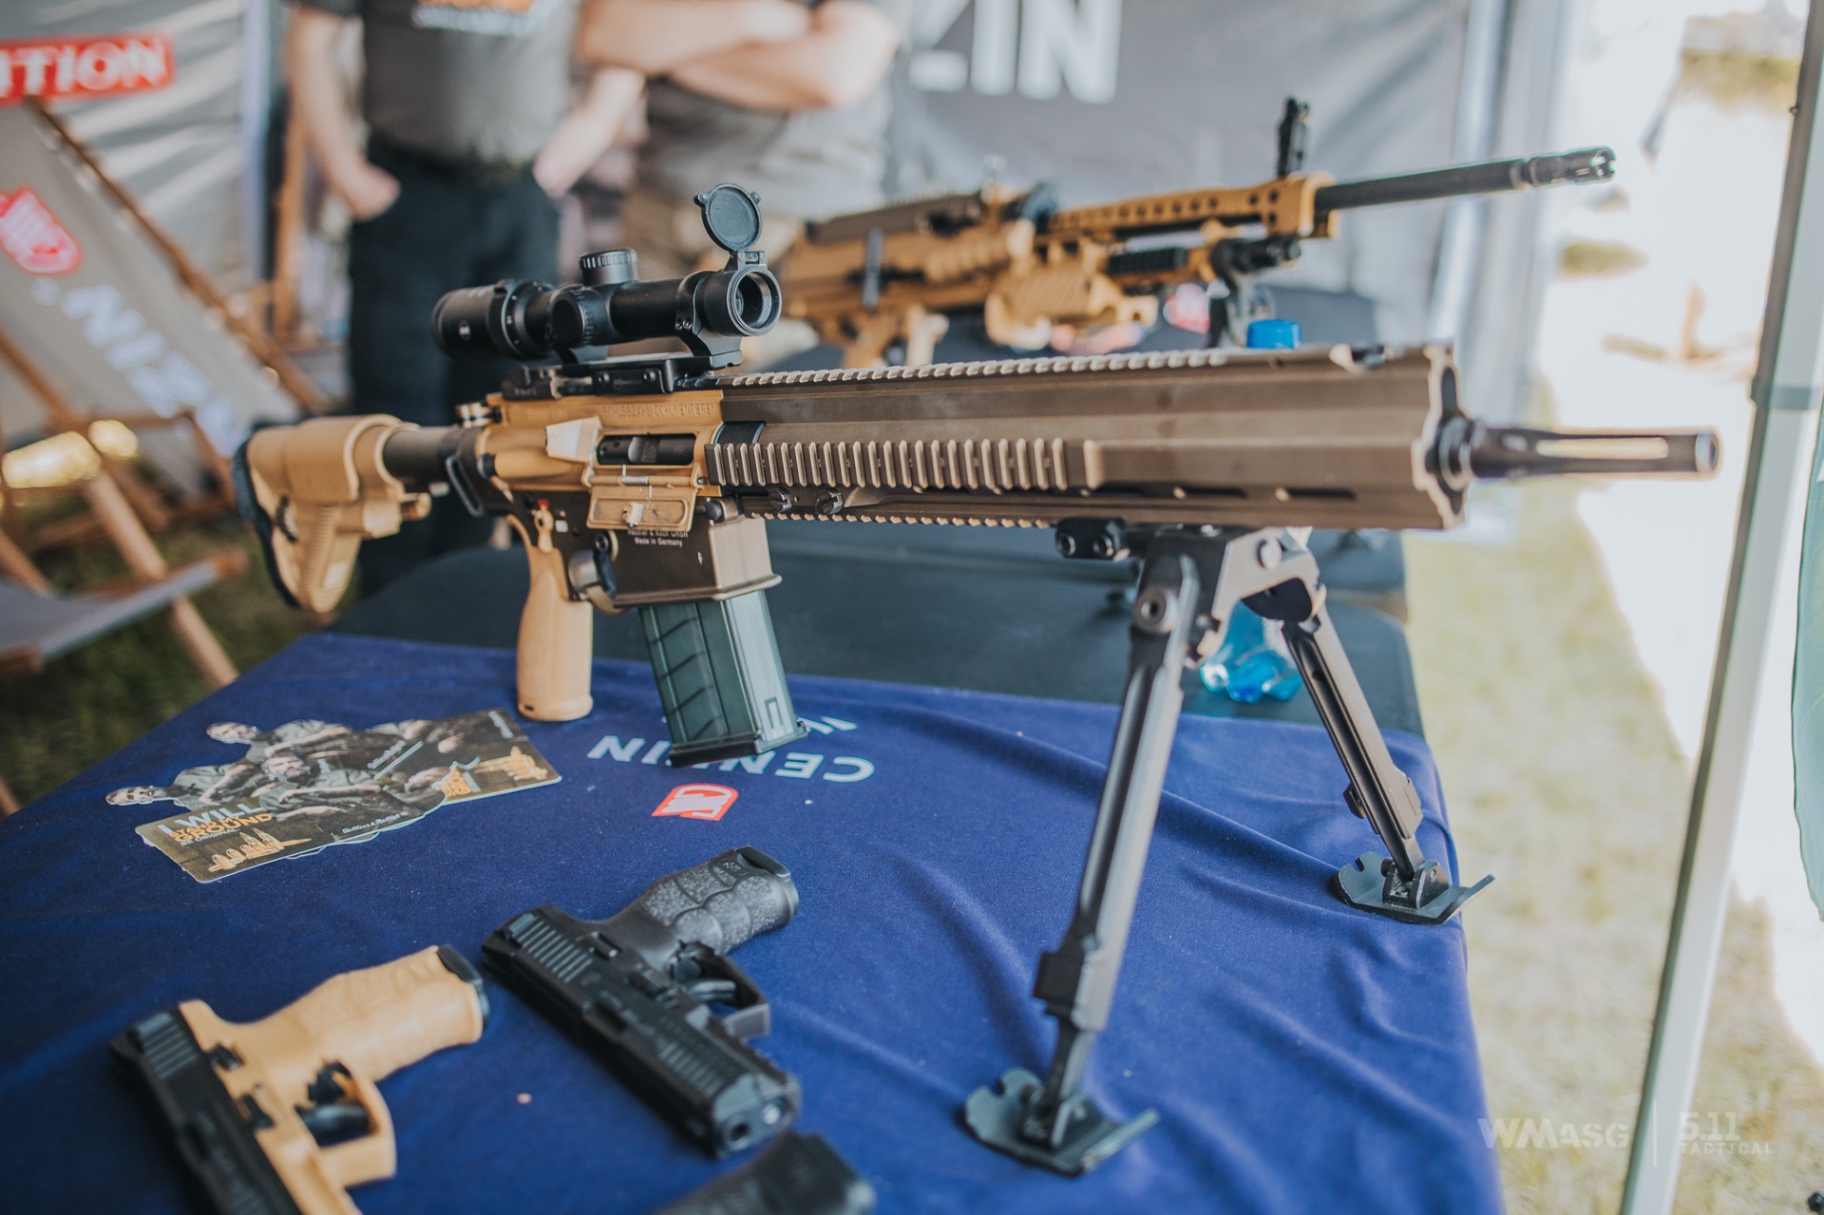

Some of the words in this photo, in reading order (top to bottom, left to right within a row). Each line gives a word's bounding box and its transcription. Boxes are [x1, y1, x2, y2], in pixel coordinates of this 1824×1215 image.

[634, 537, 650, 545] Made
[657, 538, 683, 548] Germany
[586, 734, 876, 783] CENIN
[173, 813, 272, 842] GROUND
[174, 803, 264, 828] WILL
